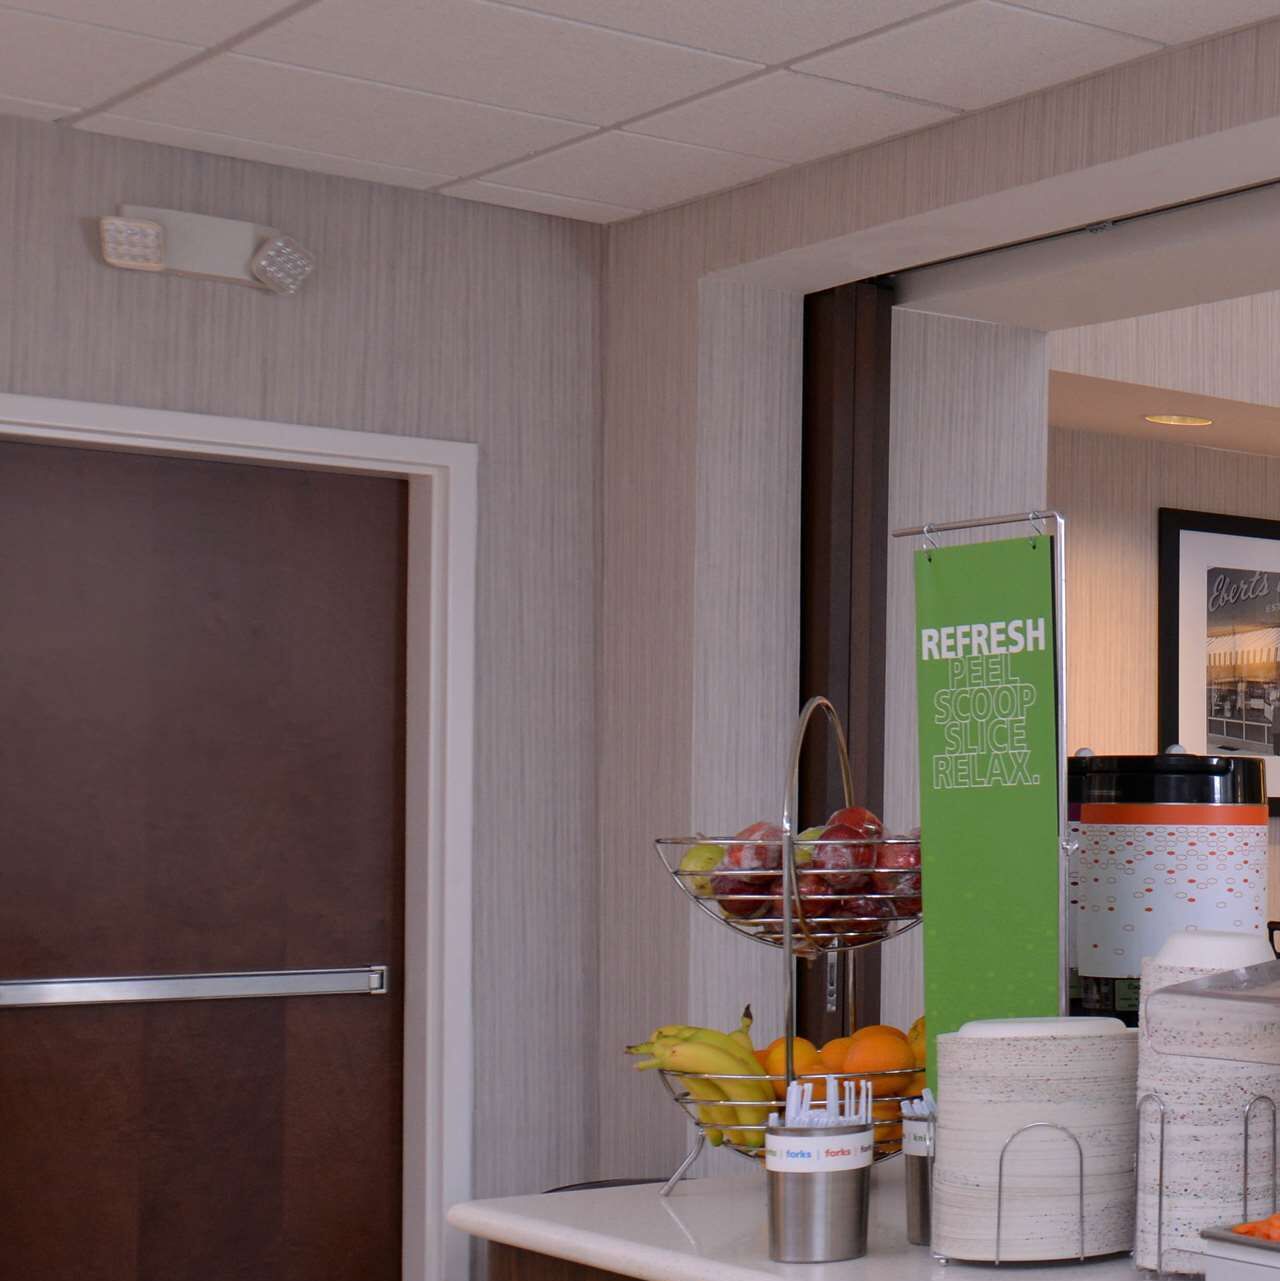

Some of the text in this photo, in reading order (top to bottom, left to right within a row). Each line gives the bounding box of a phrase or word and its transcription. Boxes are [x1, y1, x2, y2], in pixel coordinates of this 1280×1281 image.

[921, 617, 1047, 661] REFRESH
[948, 652, 1020, 691] PEEL
[933, 683, 1038, 725] SCOOP
[943, 717, 1028, 757] SLICE
[932, 749, 1041, 790] RELAX.
[785, 1149, 812, 1159] forks
